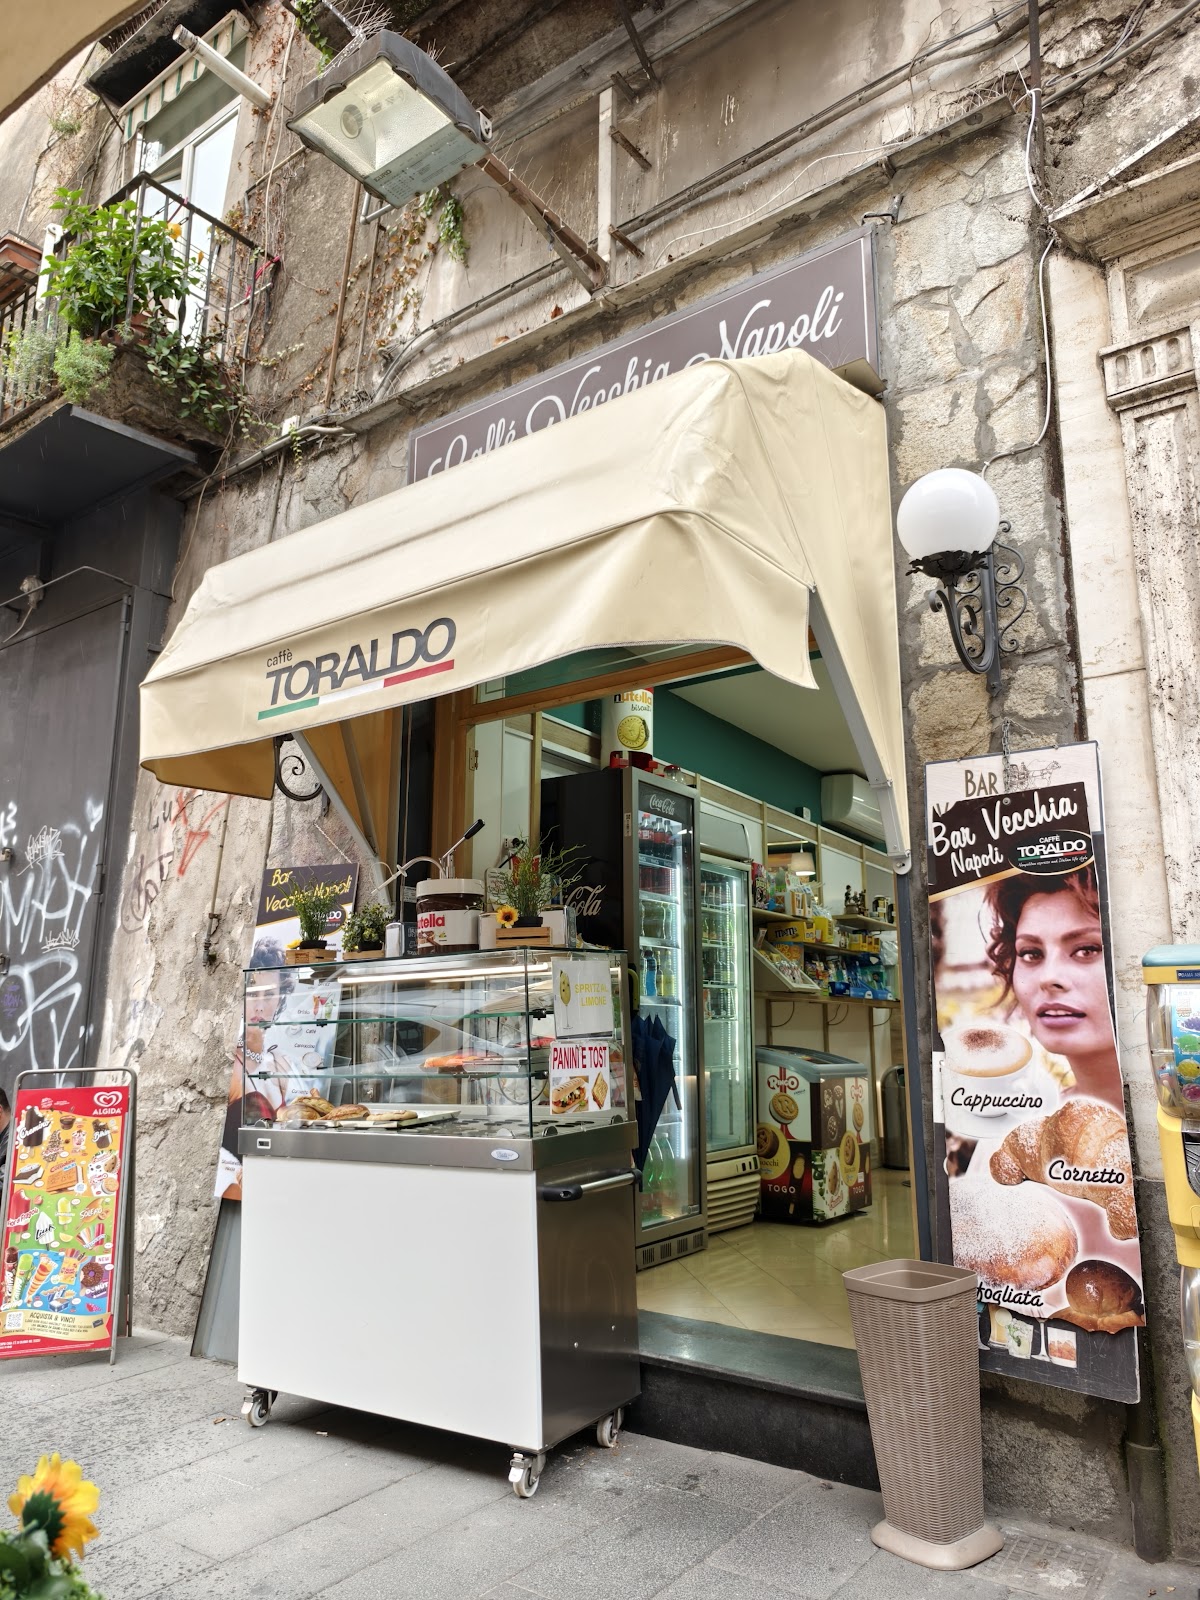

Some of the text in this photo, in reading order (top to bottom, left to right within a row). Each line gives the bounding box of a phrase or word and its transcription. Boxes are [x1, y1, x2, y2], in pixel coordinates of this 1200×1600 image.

[684, 285, 845, 371] Napoli
[266, 649, 293, 668] caffè
[266, 617, 457, 706] TORALDO
[964, 769, 999, 798] BAR
[932, 791, 1078, 857] Bar Vecchia
[1039, 833, 1061, 844] CAFFÈ
[1017, 839, 1087, 858] TORALDO
[950, 843, 1004, 878] Napoli
[271, 868, 293, 887] Bar
[575, 983, 600, 994] SPRITZ
[581, 996, 606, 1007] LIMONE
[552, 1046, 607, 1070] PANINI E TOST
[767, 1075, 799, 1090] RINGO
[951, 1087, 1043, 1109] Cappuccino
[92, 1107, 122, 1115] ALGIDA
[1048, 1159, 1125, 1184] Cornetto
[768, 1184, 796, 1194] TOGO
[976, 1282, 1044, 1307] fogliata
[30, 1312, 54, 1321] ACQUISTA
